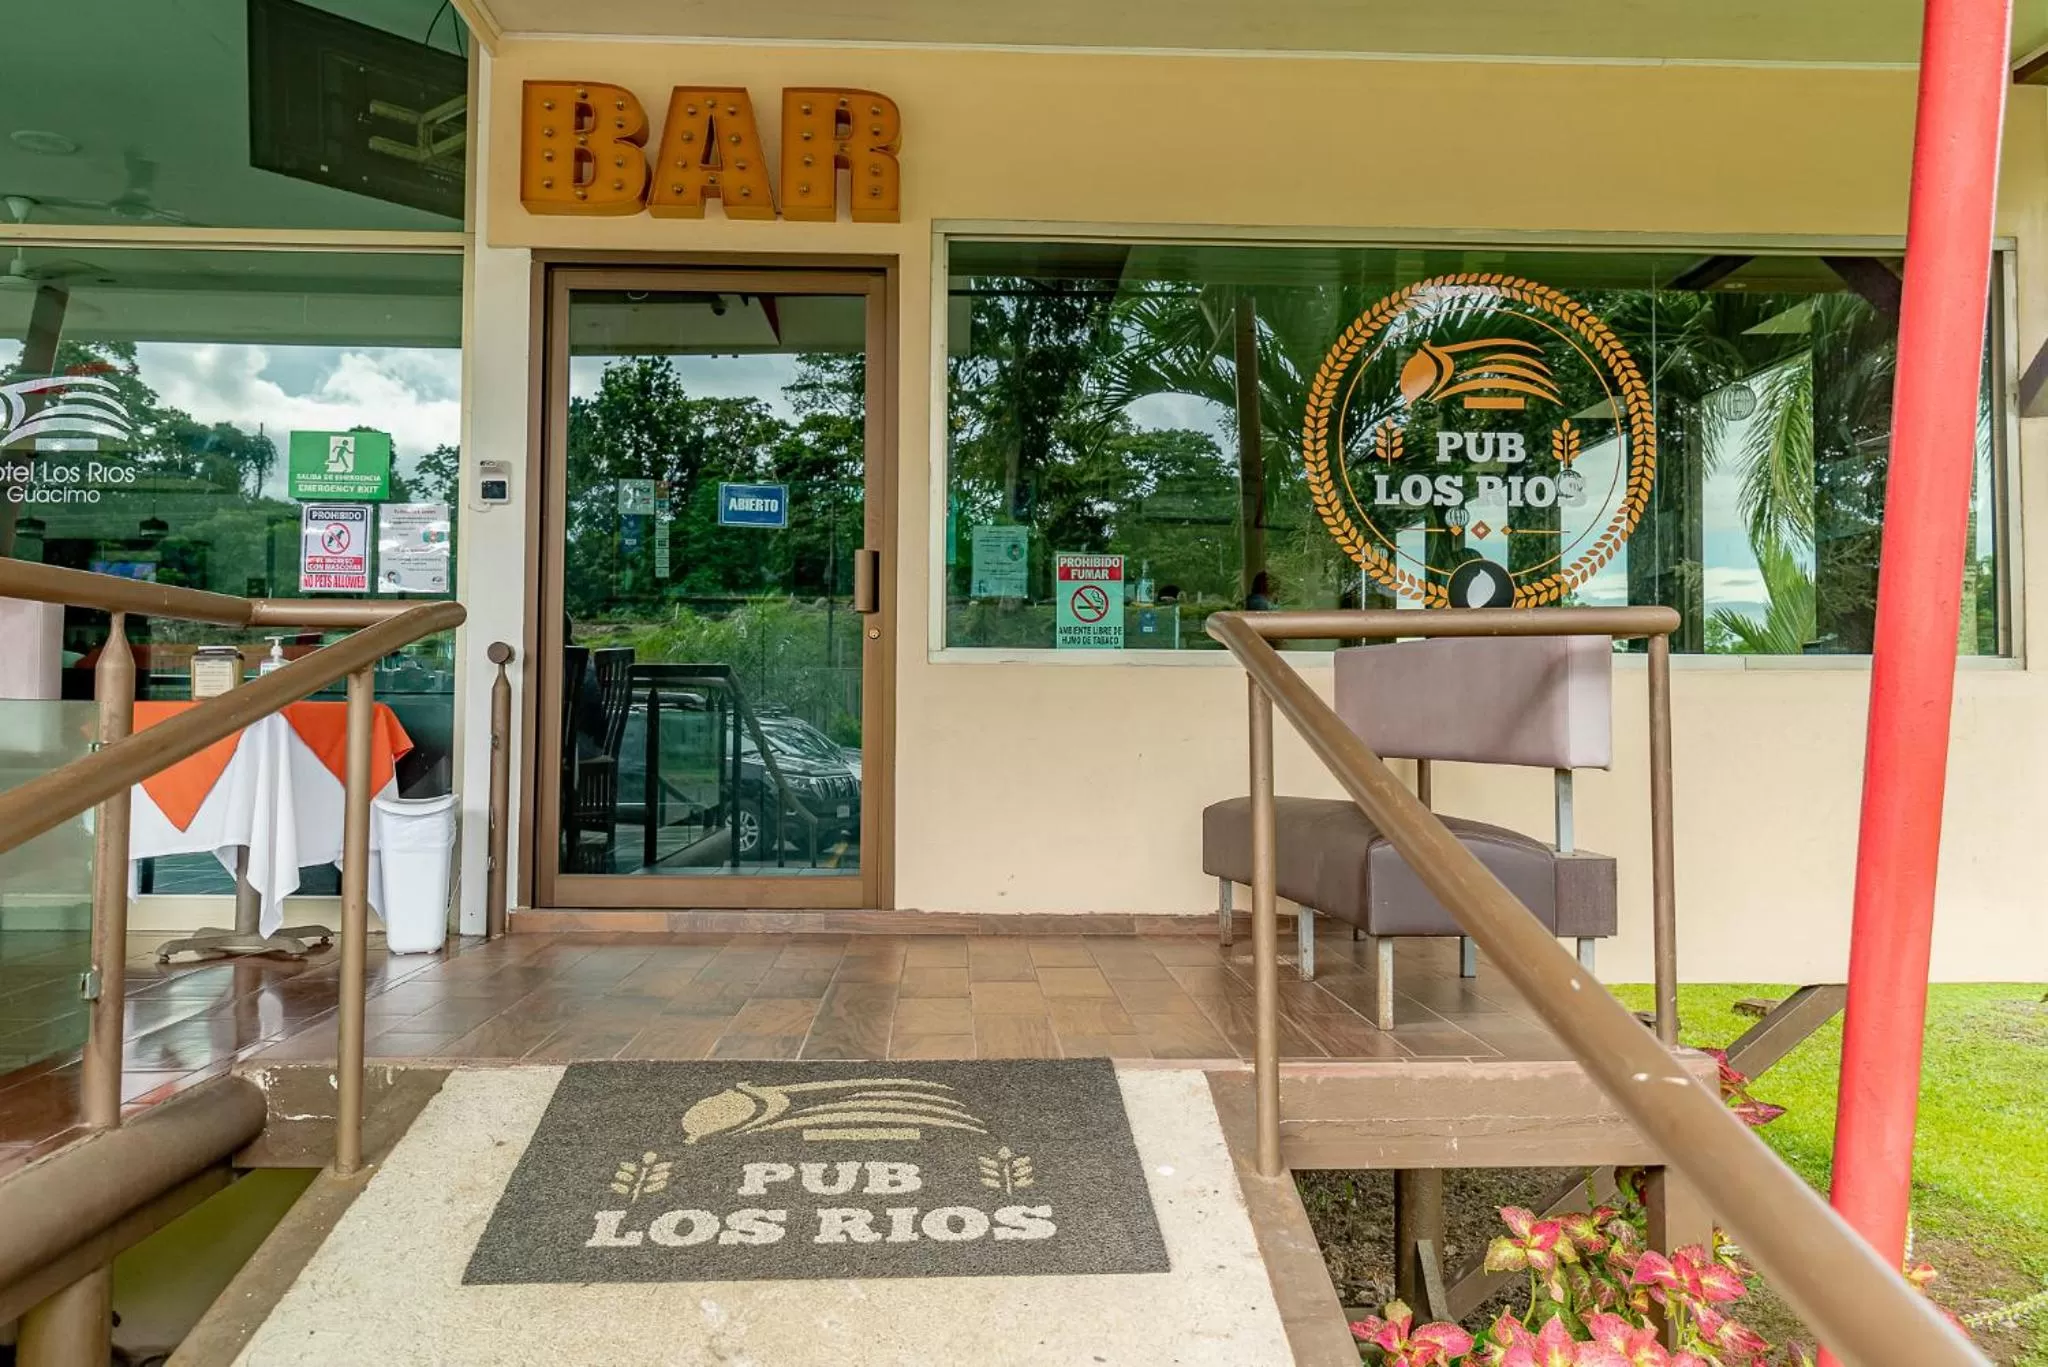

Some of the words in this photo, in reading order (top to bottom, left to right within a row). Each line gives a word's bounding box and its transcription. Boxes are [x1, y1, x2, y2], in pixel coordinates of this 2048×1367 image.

[520, 80, 901, 222] BAR
[1435, 431, 1526, 463] PUB
[43, 461, 81, 483] Los
[298, 484, 355, 493] EMERGENCY
[357, 485, 379, 493] EXIT
[1374, 474, 1464, 507] LOS
[1476, 475, 1588, 509] RIOS
[728, 497, 779, 512] ABIERTO
[312, 511, 362, 519] PROHIBIDO
[1060, 558, 1120, 567] PROHIBIDO
[1071, 569, 1109, 579] FUMAR
[304, 575, 313, 587] NO
[315, 575, 332, 588] PETS
[333, 575, 366, 588] ALLOWED
[1059, 626, 1091, 635] AMBIENTE
[1093, 626, 1112, 635] LIBRE
[1113, 627, 1122, 635] DE
[1083, 636, 1092, 645] DE
[1093, 637, 1119, 645] TABACO
[737, 1161, 923, 1197] PUB
[585, 1208, 788, 1249] LOS
[812, 1205, 1058, 1247] RIOS
